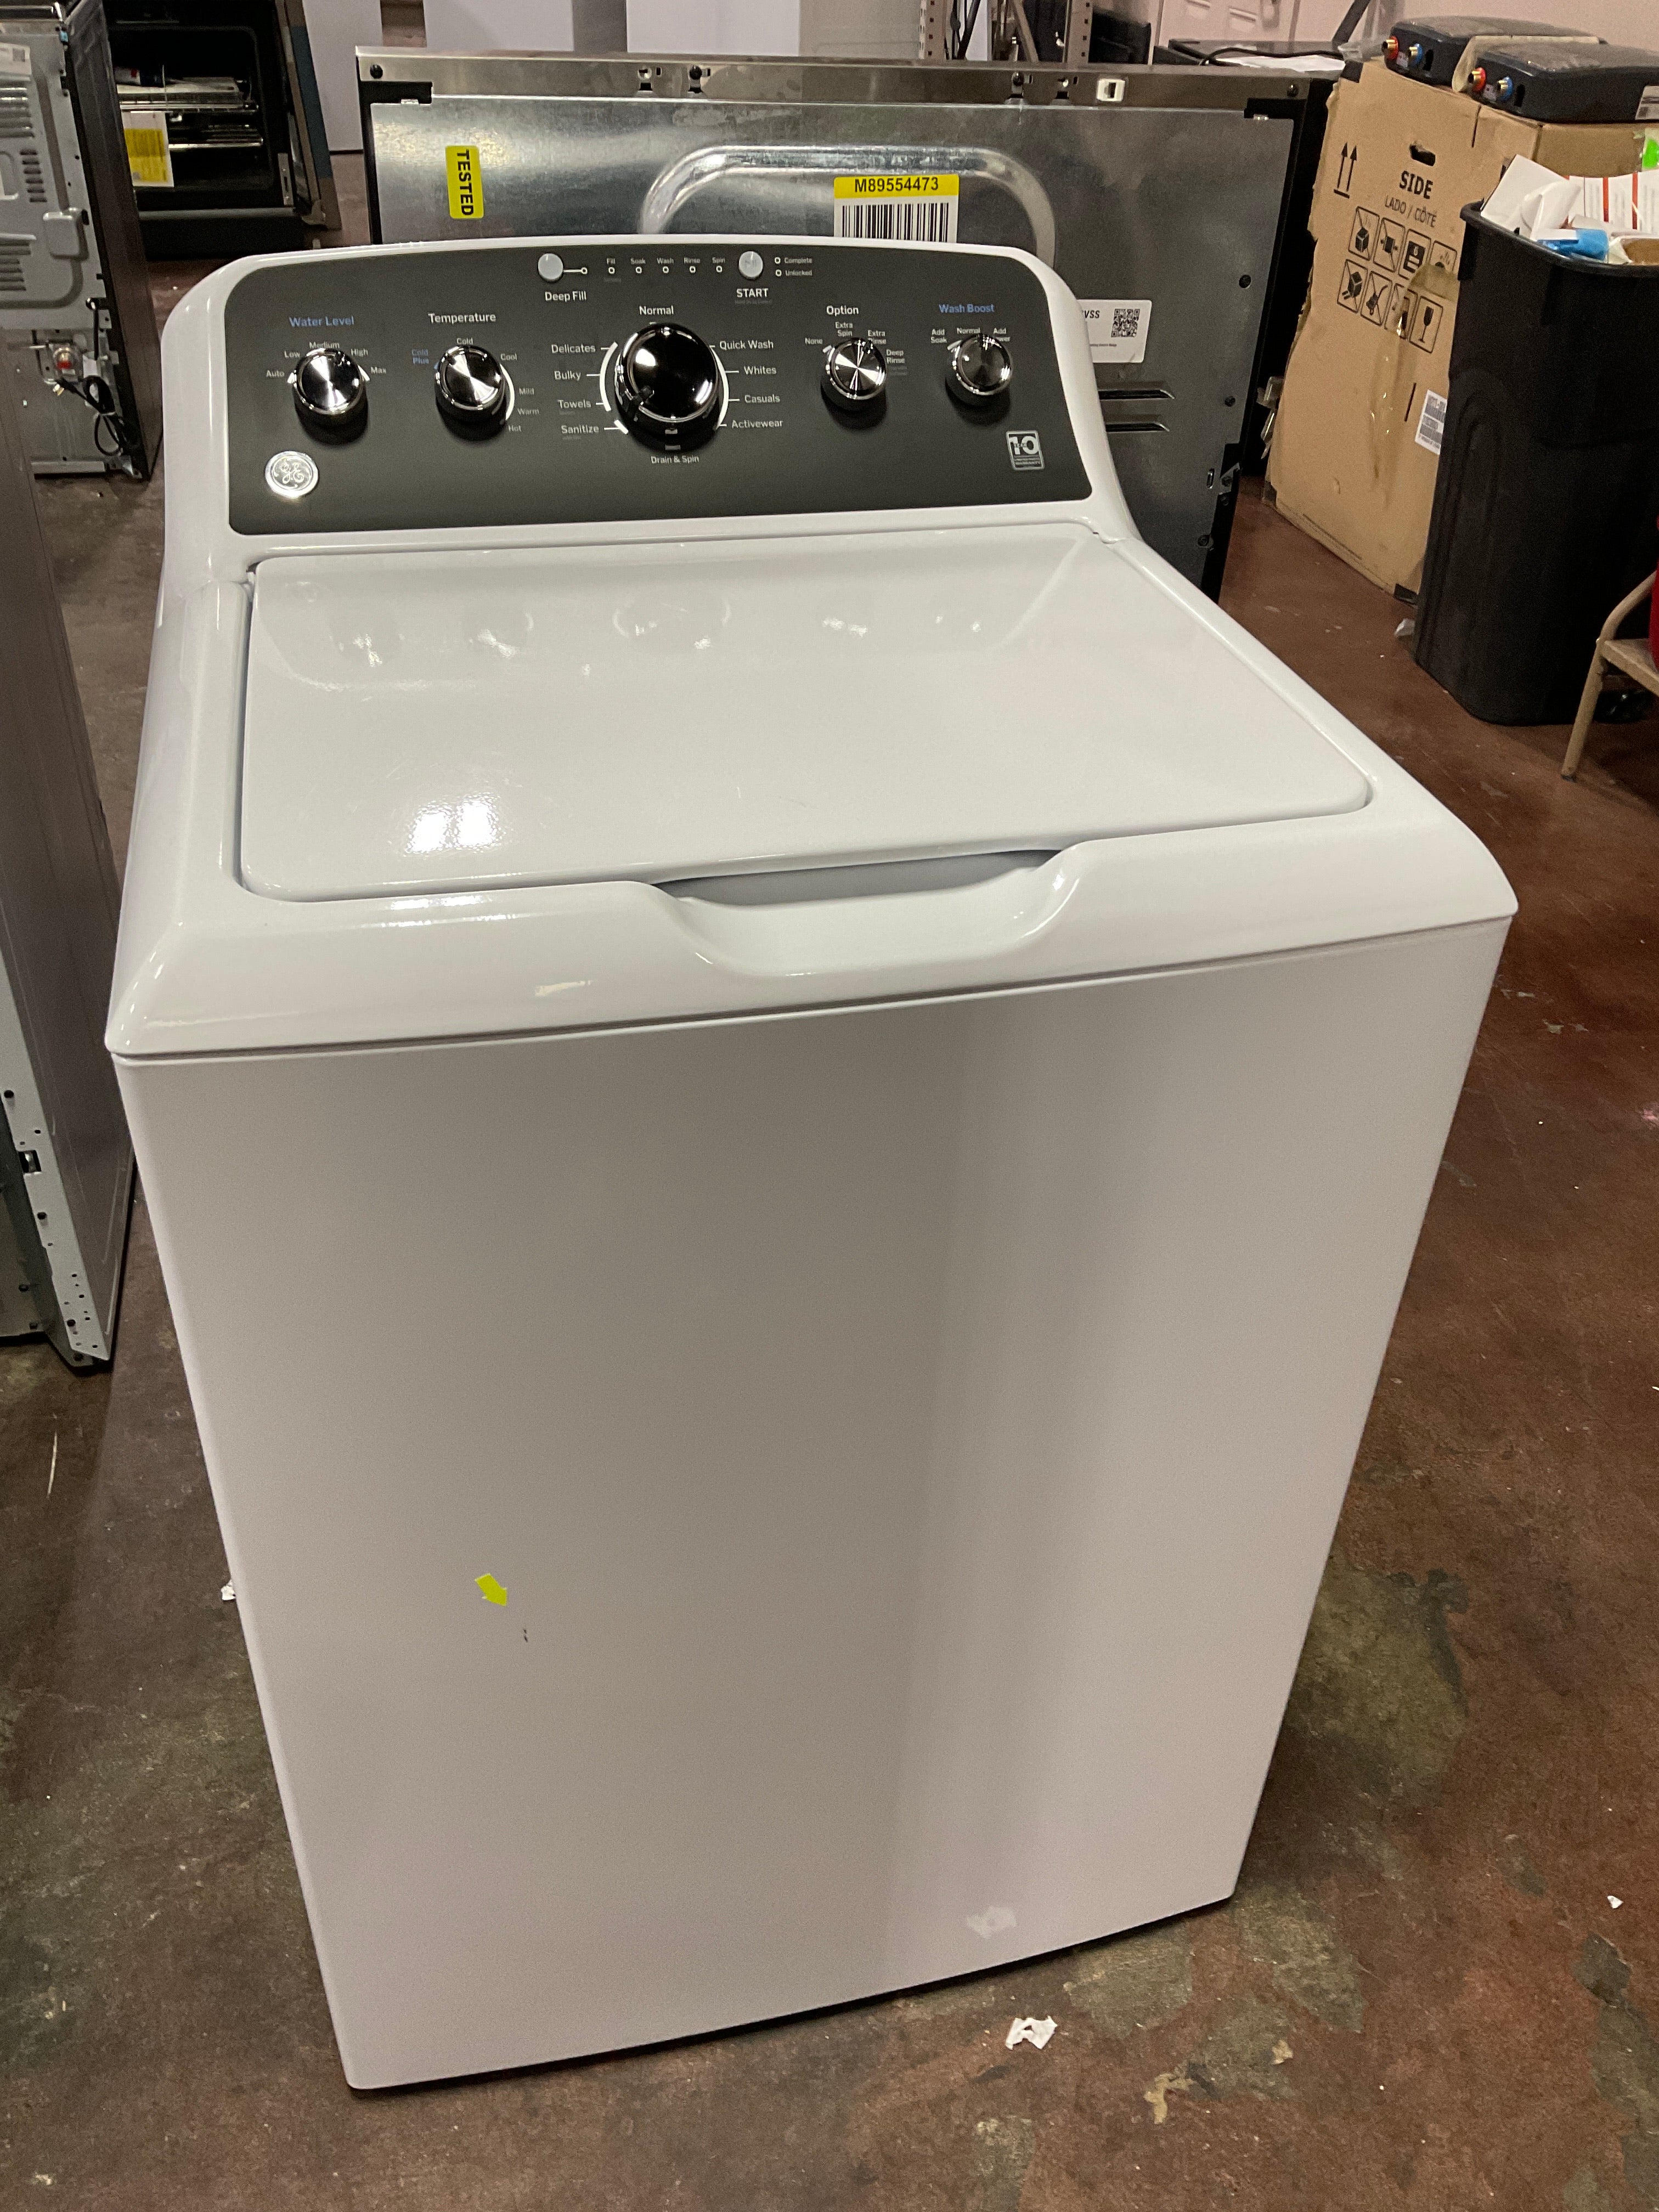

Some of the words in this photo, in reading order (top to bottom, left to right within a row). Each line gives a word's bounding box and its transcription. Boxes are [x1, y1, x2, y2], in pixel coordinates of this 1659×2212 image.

[457, 149, 473, 215] TESTED
[855, 177, 939, 193] M89554473
[1399, 170, 1434, 200] SIDE
[1385, 195, 1406, 215] LADO
[545, 291, 571, 302] Deep
[572, 291, 587, 301] Fill
[736, 288, 769, 298] START
[639, 305, 675, 315] Normal
[826, 305, 859, 316] Option
[939, 304, 965, 313] Wash
[967, 304, 995, 313] Boost
[428, 312, 496, 324] Temperature
[1081, 309, 1100, 319] VSS
[289, 316, 323, 328] Water
[325, 315, 354, 326] Level
[551, 344, 596, 354] Delicates
[719, 341, 746, 351] Quick
[748, 340, 774, 349] Wash
[284, 351, 301, 359] Low
[351, 348, 369, 357] High
[266, 370, 285, 378] Auto
[554, 370, 582, 381] Bulky
[743, 366, 777, 375] Whites
[518, 387, 535, 396] Mild
[557, 399, 591, 409] Towels
[744, 394, 781, 404] Casuals
[731, 419, 783, 428] Activewear
[561, 425, 599, 435] Sanitize
[651, 456, 672, 464] Drain
[682, 455, 699, 464] Spin
